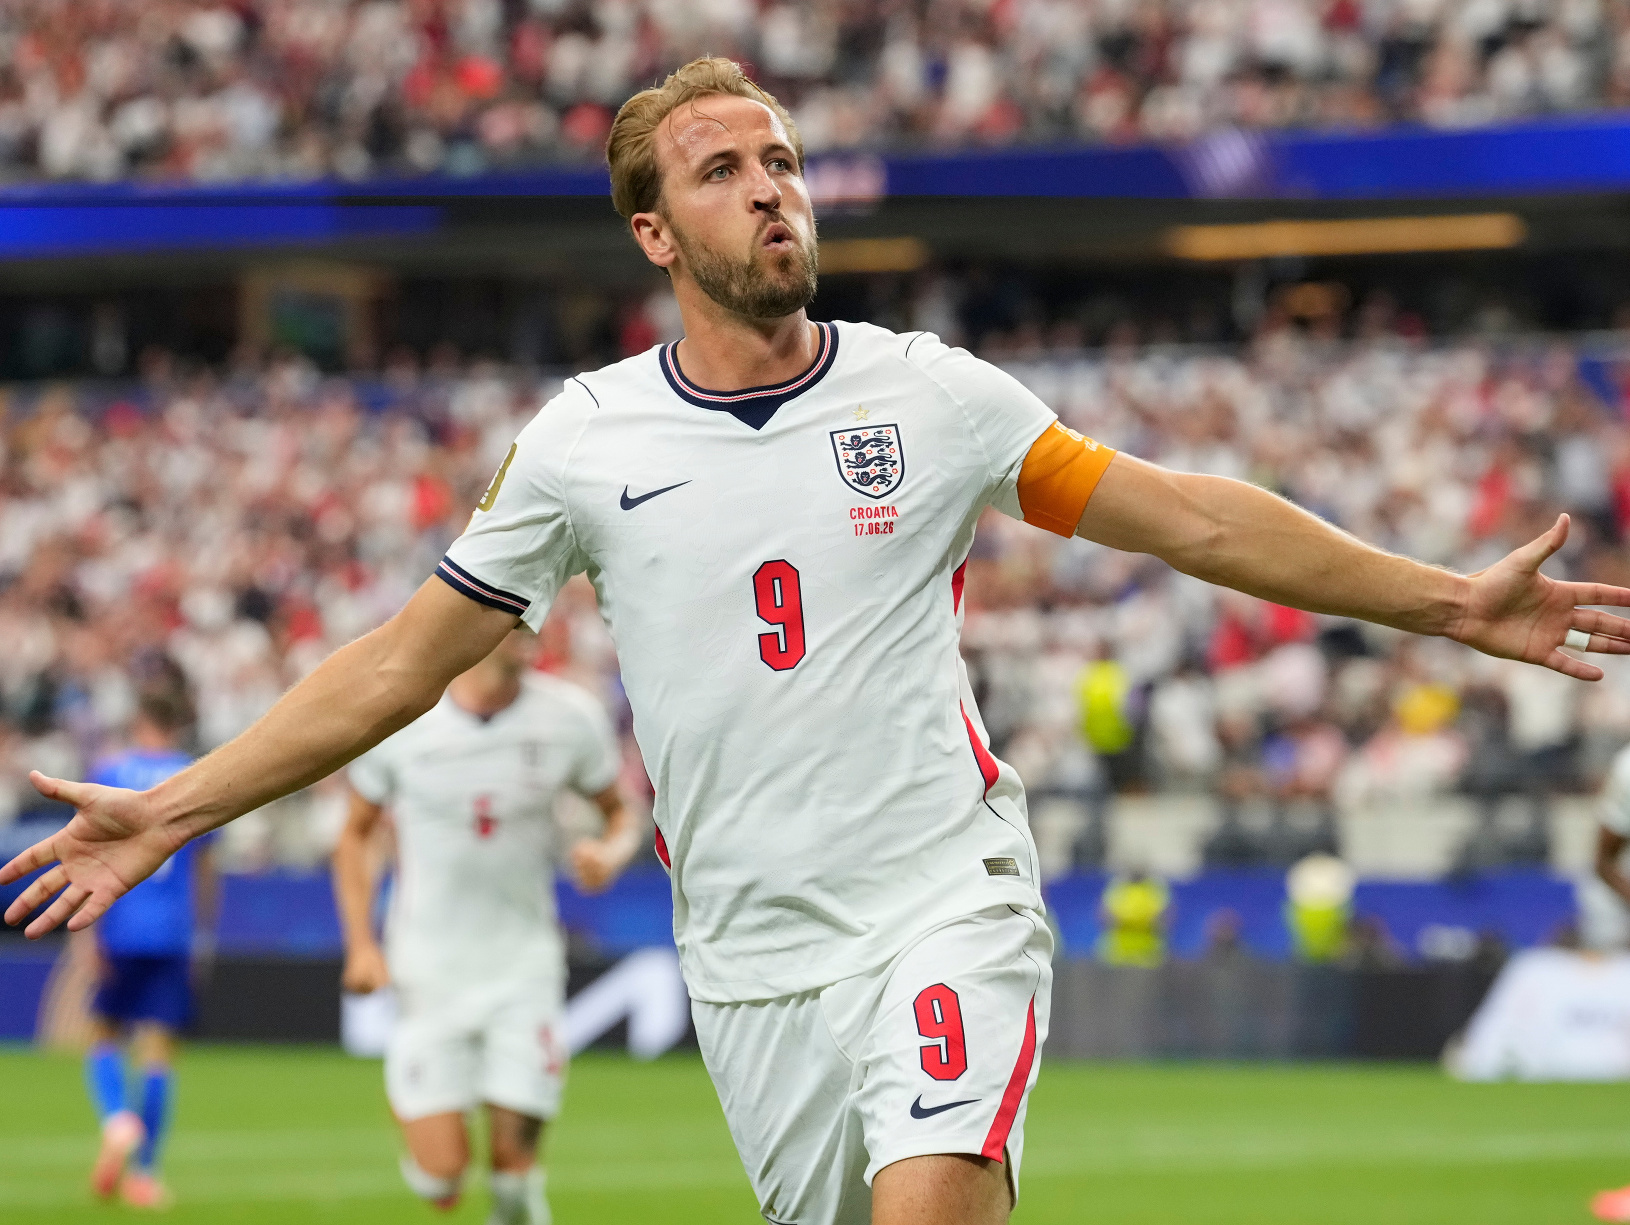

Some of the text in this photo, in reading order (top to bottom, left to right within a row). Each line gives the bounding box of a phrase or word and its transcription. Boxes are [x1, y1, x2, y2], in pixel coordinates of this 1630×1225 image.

[849, 505, 899, 520] CROATIA
[854, 521, 894, 537] 17.06.26
[752, 559, 806, 671] 9
[912, 982, 968, 1081] 9
